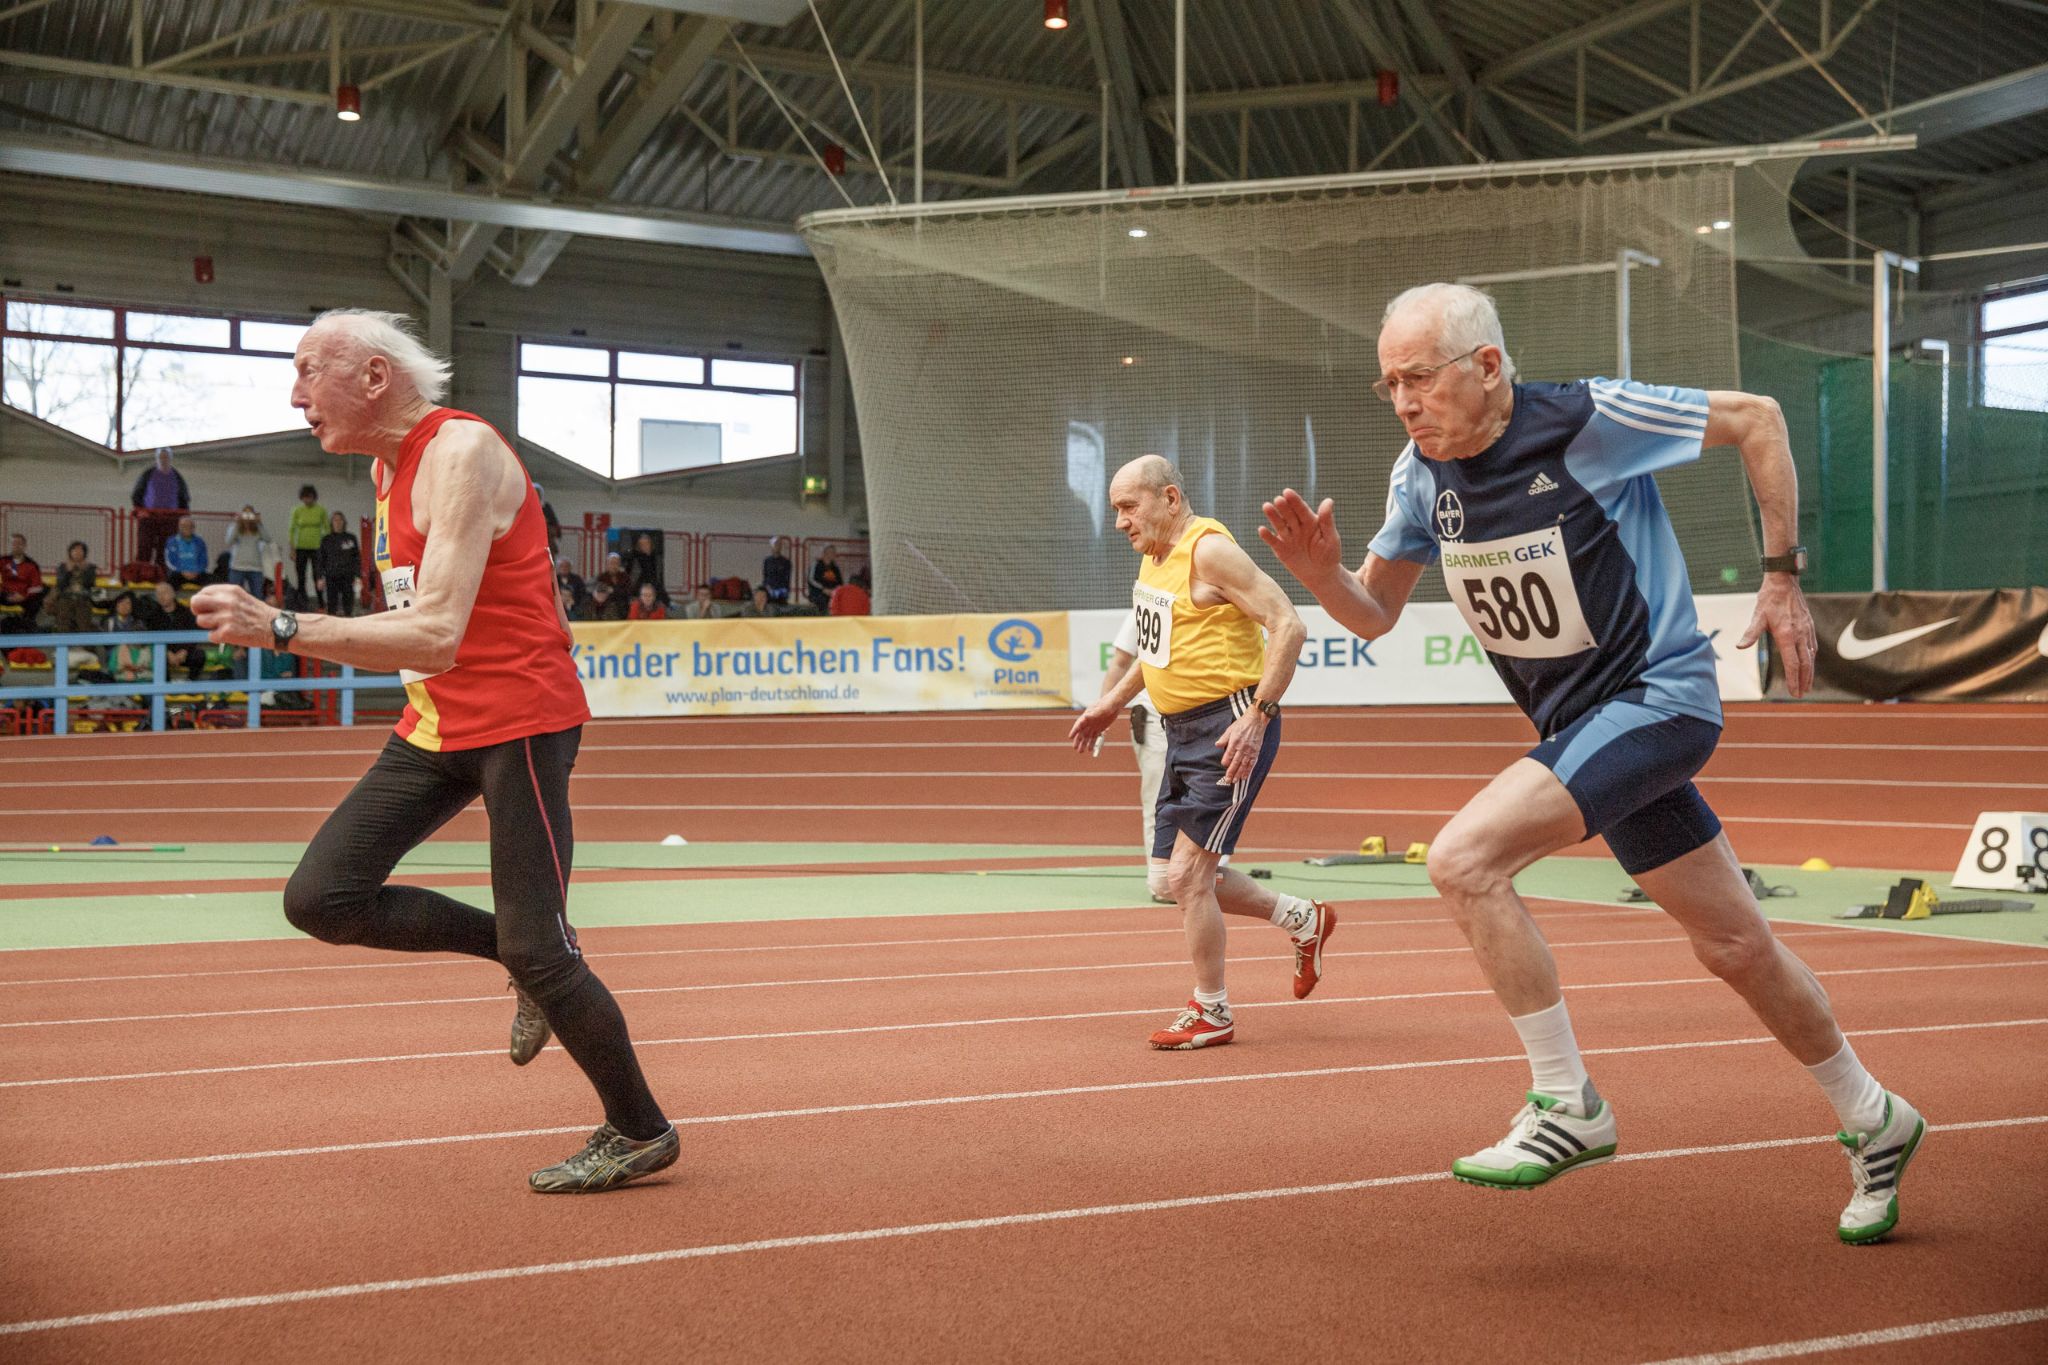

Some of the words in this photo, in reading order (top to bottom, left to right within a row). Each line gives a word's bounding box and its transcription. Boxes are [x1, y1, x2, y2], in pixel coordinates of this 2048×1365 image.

[1528, 482, 1559, 496] adidas
[1439, 509, 1461, 519] BAYER
[1444, 550, 1512, 568] BARMER
[1514, 541, 1557, 562] GEK
[1154, 596, 1170, 608] GEK
[1463, 571, 1561, 641] 580
[1136, 604, 1161, 655] 699
[693, 639, 860, 678] brauchen
[872, 635, 965, 673] Fans!
[1296, 637, 1377, 668] GEK
[994, 667, 1039, 685] Plan
[666, 684, 860, 706] www.plan-deutschland.de
[1977, 826, 2009, 874] 8
